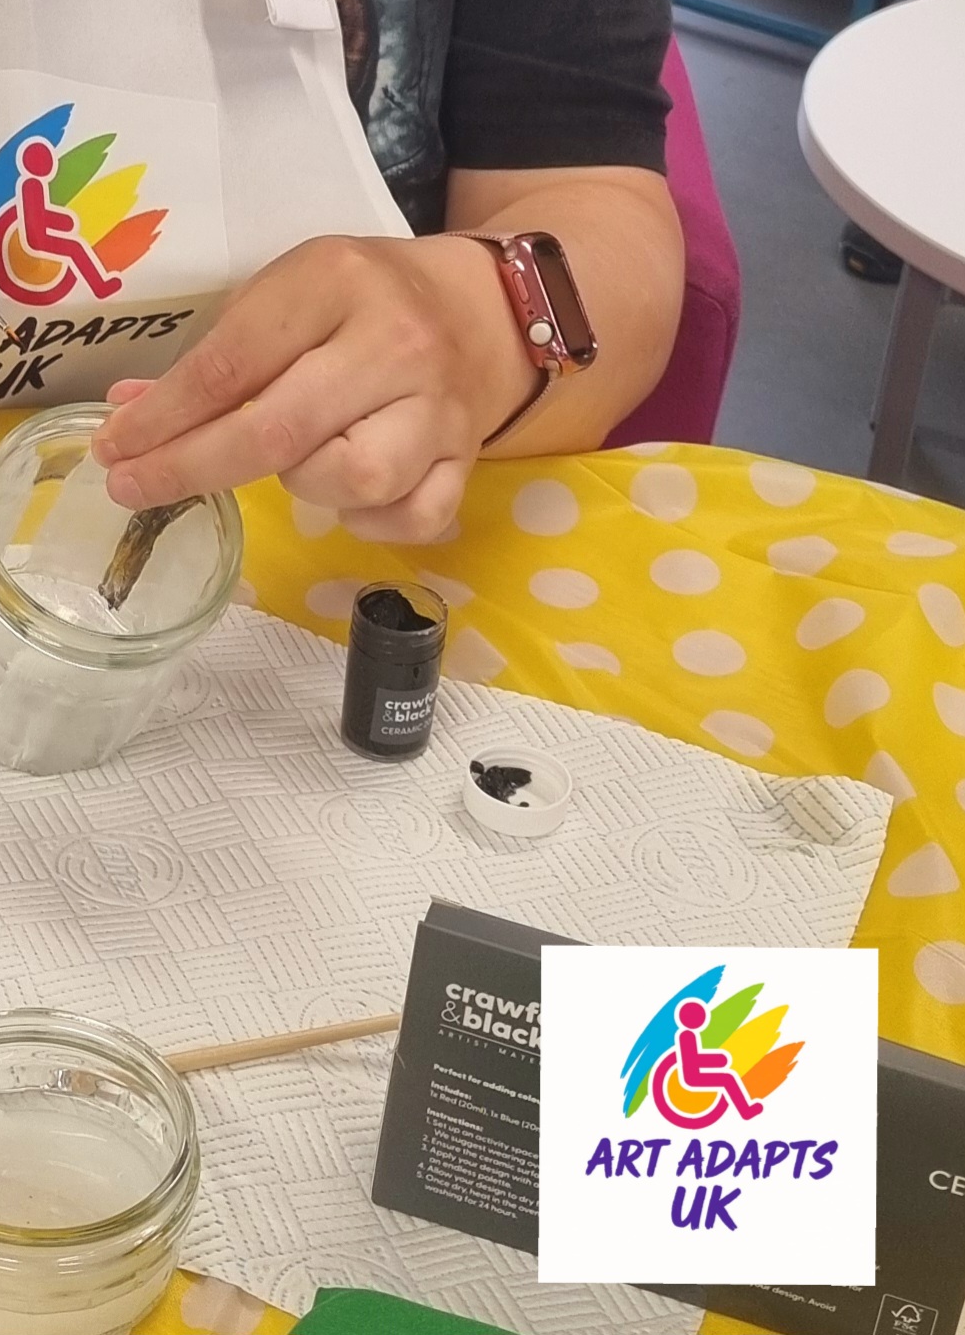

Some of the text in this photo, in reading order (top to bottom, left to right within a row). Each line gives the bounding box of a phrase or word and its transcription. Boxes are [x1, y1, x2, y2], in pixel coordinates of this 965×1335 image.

[445, 983, 541, 1024] crawf
[438, 1028, 541, 1067] ARTIST MATE
[430, 1080, 472, 1101] Includes:
[433, 1063, 467, 1081] Perfect
[468, 1075, 482, 1086] for
[483, 1081, 517, 1099] adding
[426, 1107, 484, 1133] Instructions:
[439, 1093, 457, 1105] Red
[500, 1113, 521, 1126] Blue
[431, 1137, 462, 1154] Ensure
[462, 1148, 478, 1159] the
[478, 1154, 516, 1172] ceramic
[432, 1118, 448, 1130] Set
[448, 1124, 461, 1135] up
[461, 1130, 475, 1139] an
[475, 1134, 510, 1152] activity
[510, 1145, 539, 1161] space
[434, 1128, 450, 1140] We
[451, 1134, 487, 1153] suggest
[487, 1147, 527, 1167] wearing
[428, 1157, 513, 1190] an endless palette.
[429, 1146, 457, 1163] Apply
[458, 1156, 479, 1168] your
[479, 1162, 511, 1179] design
[511, 1174, 533, 1187] with
[424, 1183, 464, 1203] washing
[464, 1194, 478, 1206] for
[478, 1200, 491, 1211] 24
[425, 1173, 451, 1188] Once
[469, 1188, 492, 1202] heat
[491, 1195, 502, 1205] in
[501, 1199, 518, 1210] the
[426, 1165, 453, 1180] Allow
[454, 1173, 475, 1186] your
[475, 1181, 507, 1198] design
[507, 1191, 519, 1201] to
[518, 1195, 535, 1207] dry
[771, 1286, 806, 1303] design.
[807, 1298, 837, 1313] Avoid
